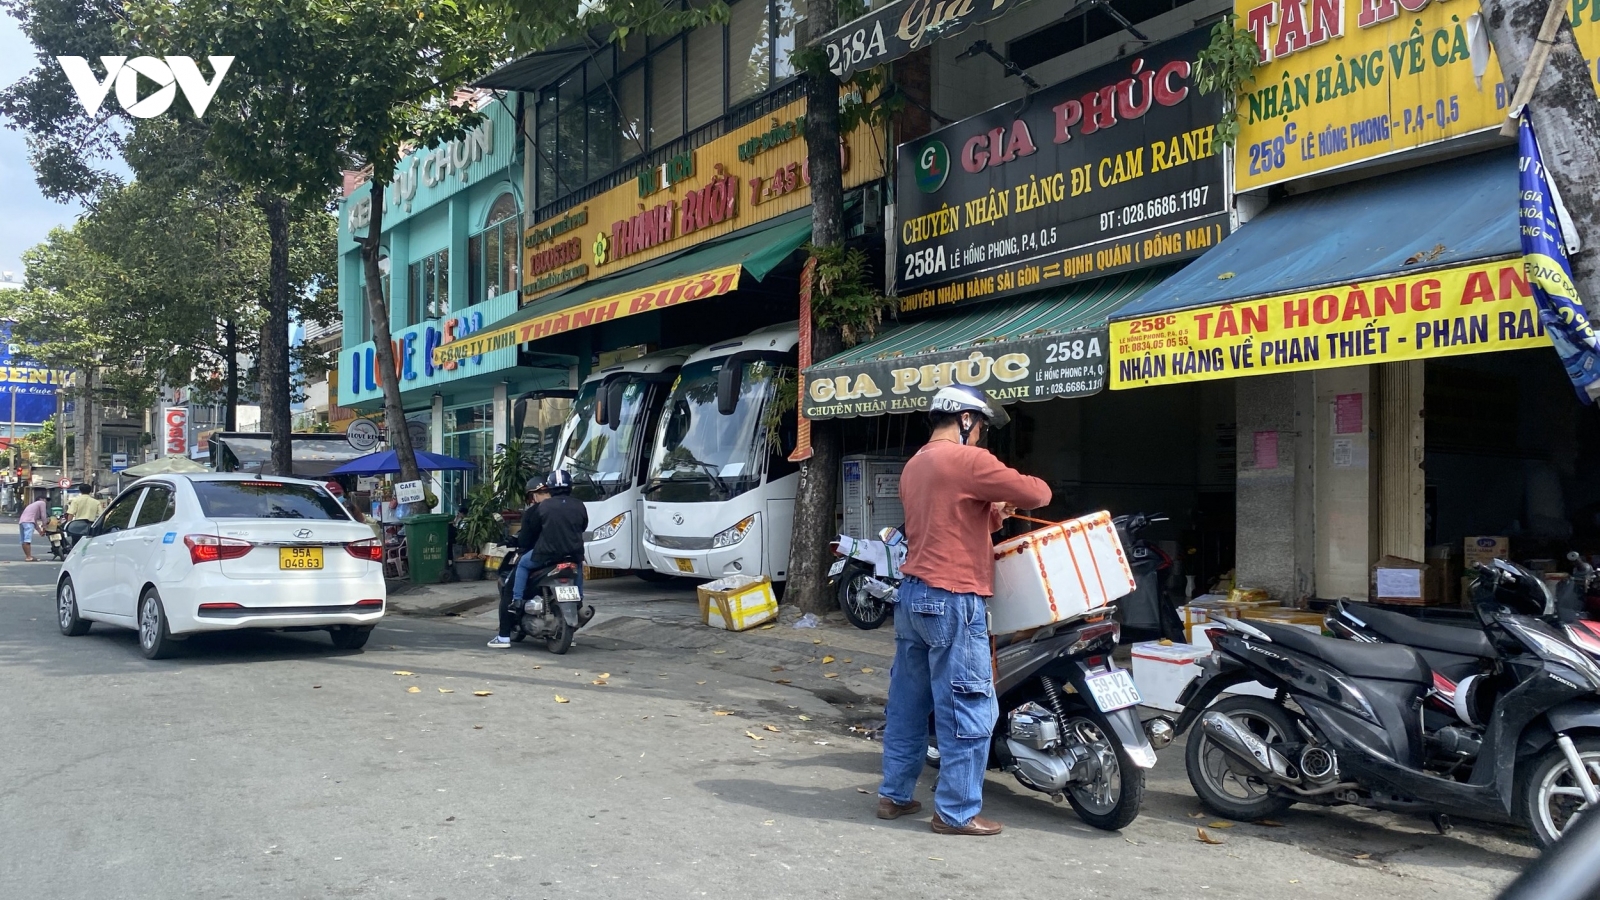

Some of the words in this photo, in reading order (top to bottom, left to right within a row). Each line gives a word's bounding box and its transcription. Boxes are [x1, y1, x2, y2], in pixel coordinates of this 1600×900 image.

[826, 20, 887, 76] 258A
[1248, 70, 1311, 126] NHẬN
[1315, 54, 1384, 104] HÀNG
[1388, 19, 1425, 79] VỀ
[961, 119, 1037, 173] GIA
[1053, 58, 1191, 144] PHÚC
[1301, 131, 1315, 161] LÊ
[1318, 123, 1347, 157] HỒNG
[1350, 114, 1389, 148] PHONG
[349, 198, 387, 234] KE
[422, 119, 494, 188] CHỌN
[902, 202, 960, 246] CHUYÊN
[965, 187, 1009, 227] NHẬN
[1015, 174, 1066, 213] HÀNG
[1071, 164, 1092, 197] ĐI
[1098, 147, 1143, 188] CAM
[1151, 125, 1215, 173] RANH
[612, 203, 675, 259] THÀNH
[681, 163, 737, 235] BƯỞI
[904, 245, 946, 281] 258A
[950, 248, 960, 270] LÊ
[964, 242, 986, 266] HỒNG
[988, 236, 1020, 260] PHONG,
[1040, 227, 1057, 247] Q.5
[1122, 185, 1209, 226] 028.6686.1197
[900, 289, 935, 312] CHUYÊN
[938, 282, 964, 304] NHẬN
[967, 277, 994, 298] HÀNG
[997, 270, 1014, 291] SÀI
[1017, 264, 1039, 287] GÒN
[1064, 253, 1093, 279] ĐỊNH
[1096, 242, 1131, 271] QUÁN
[1144, 231, 1182, 260] ĐỒNG
[1186, 226, 1211, 250] NAI
[441, 345, 468, 363] CÔNG
[471, 340, 484, 356] TY
[487, 330, 516, 352] TNHH
[521, 301, 620, 342] THÀNH
[628, 273, 736, 314] BƯỞI
[1130, 315, 1176, 334] 258C
[1193, 304, 1268, 341] TÂN
[1283, 282, 1441, 329] HOÀNG
[1045, 337, 1102, 364] 258A
[1119, 352, 1166, 384] NHẬN
[1172, 346, 1224, 376] HÀNG
[1229, 335, 1254, 370] VỀ
[1261, 334, 1320, 366] PHAN
[1326, 319, 1390, 359] THIẾT
[1416, 313, 1488, 350] PHAN
[1132, 339, 1163, 352] 0834.05
[1166, 338, 1176, 347] 05
[1178, 336, 1189, 346] 53
[353, 352, 361, 394] I
[809, 372, 883, 402] GIA
[891, 351, 1030, 394] PHÚC
[1035, 366, 1043, 382] LÊ
[1060, 367, 1082, 379] PHONG
[807, 402, 851, 416] CHUYÊN
[855, 398, 887, 414] NHẬN
[891, 396, 927, 410] HÀNG
[986, 385, 1029, 400] RANH
[400, 482, 416, 490] CAFE
[285, 559, 319, 569] 048.63
[292, 547, 311, 558] 95A
[1092, 673, 1128, 693] 59-V2
[1097, 687, 1139, 710] 880.16
[1549, 673, 1577, 689] HONDA
